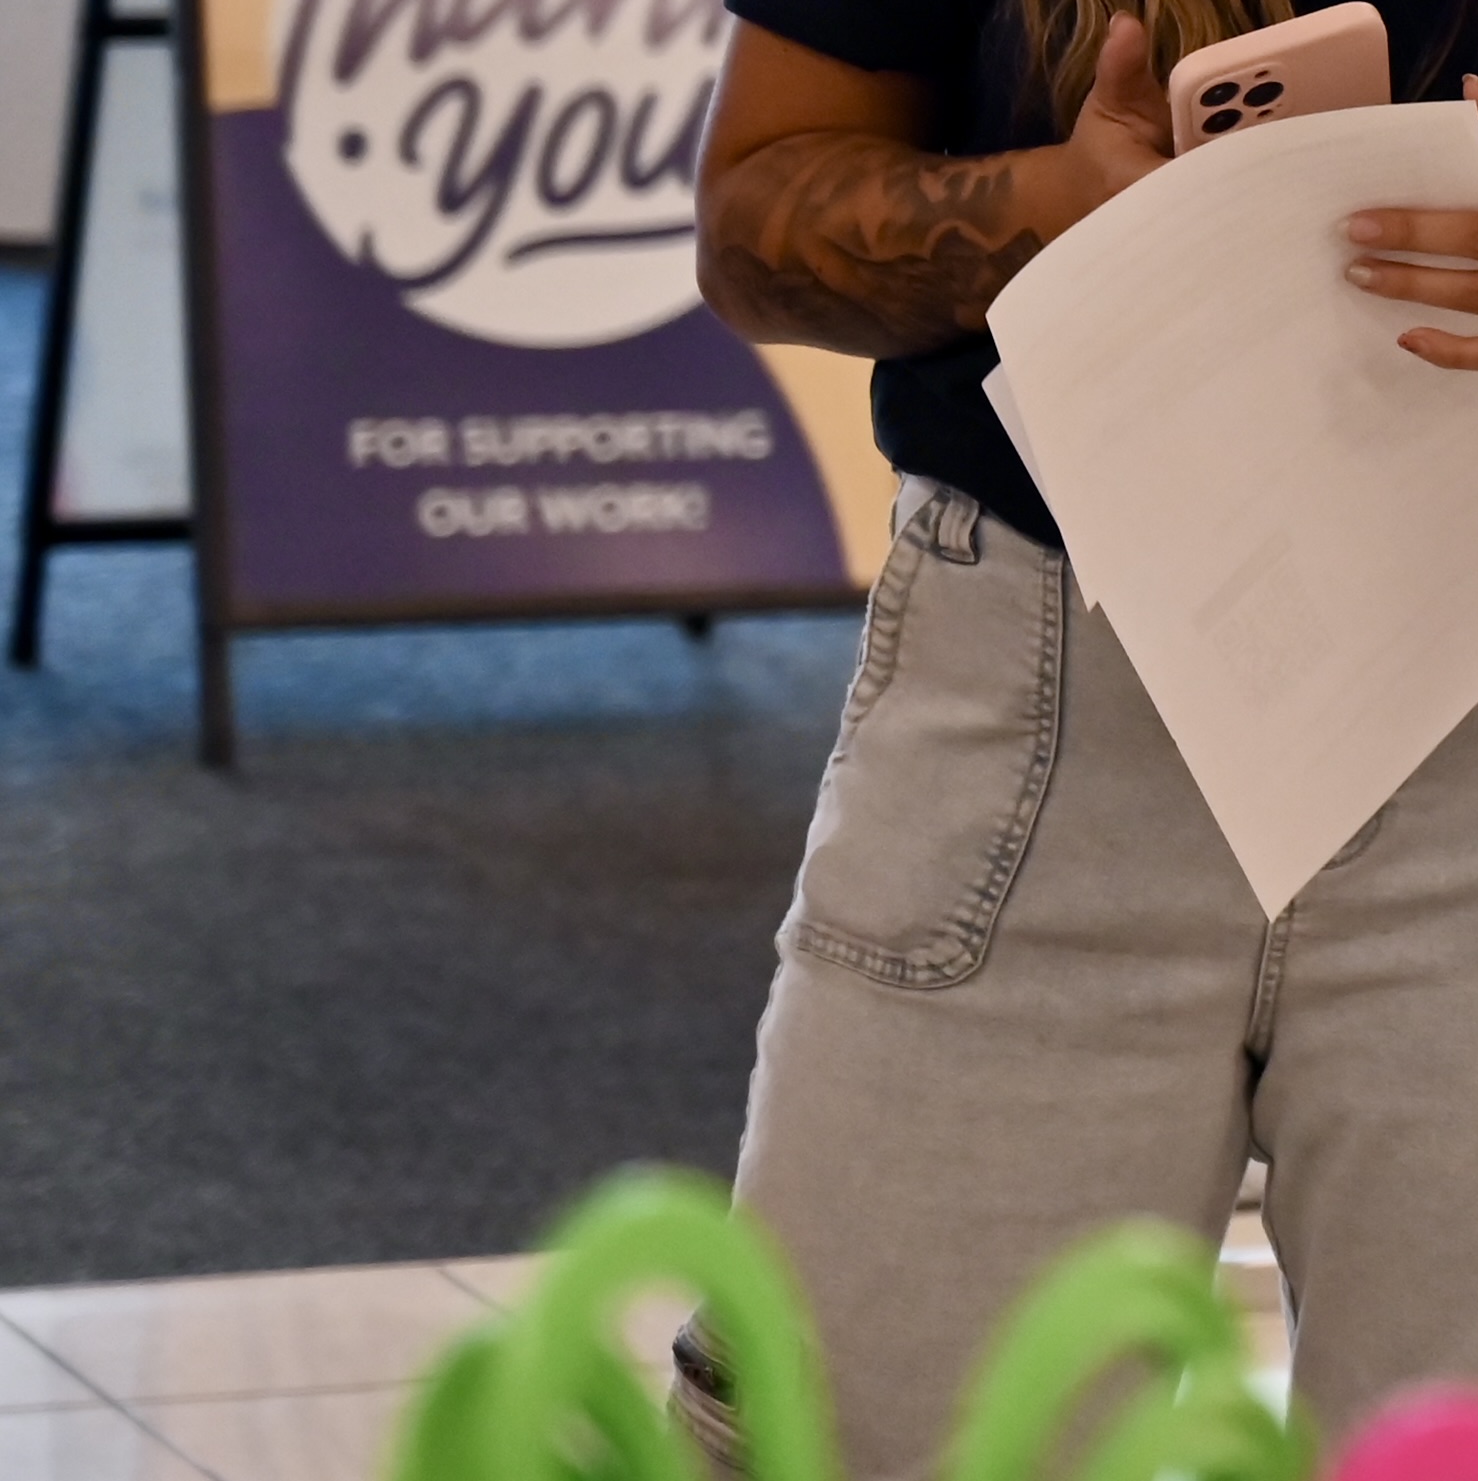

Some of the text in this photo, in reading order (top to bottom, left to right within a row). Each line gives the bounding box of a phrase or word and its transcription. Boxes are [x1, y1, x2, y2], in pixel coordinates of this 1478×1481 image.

[348, 410, 774, 469] FOR SUPPORTING
[417, 483, 709, 537] OUR WORK!
